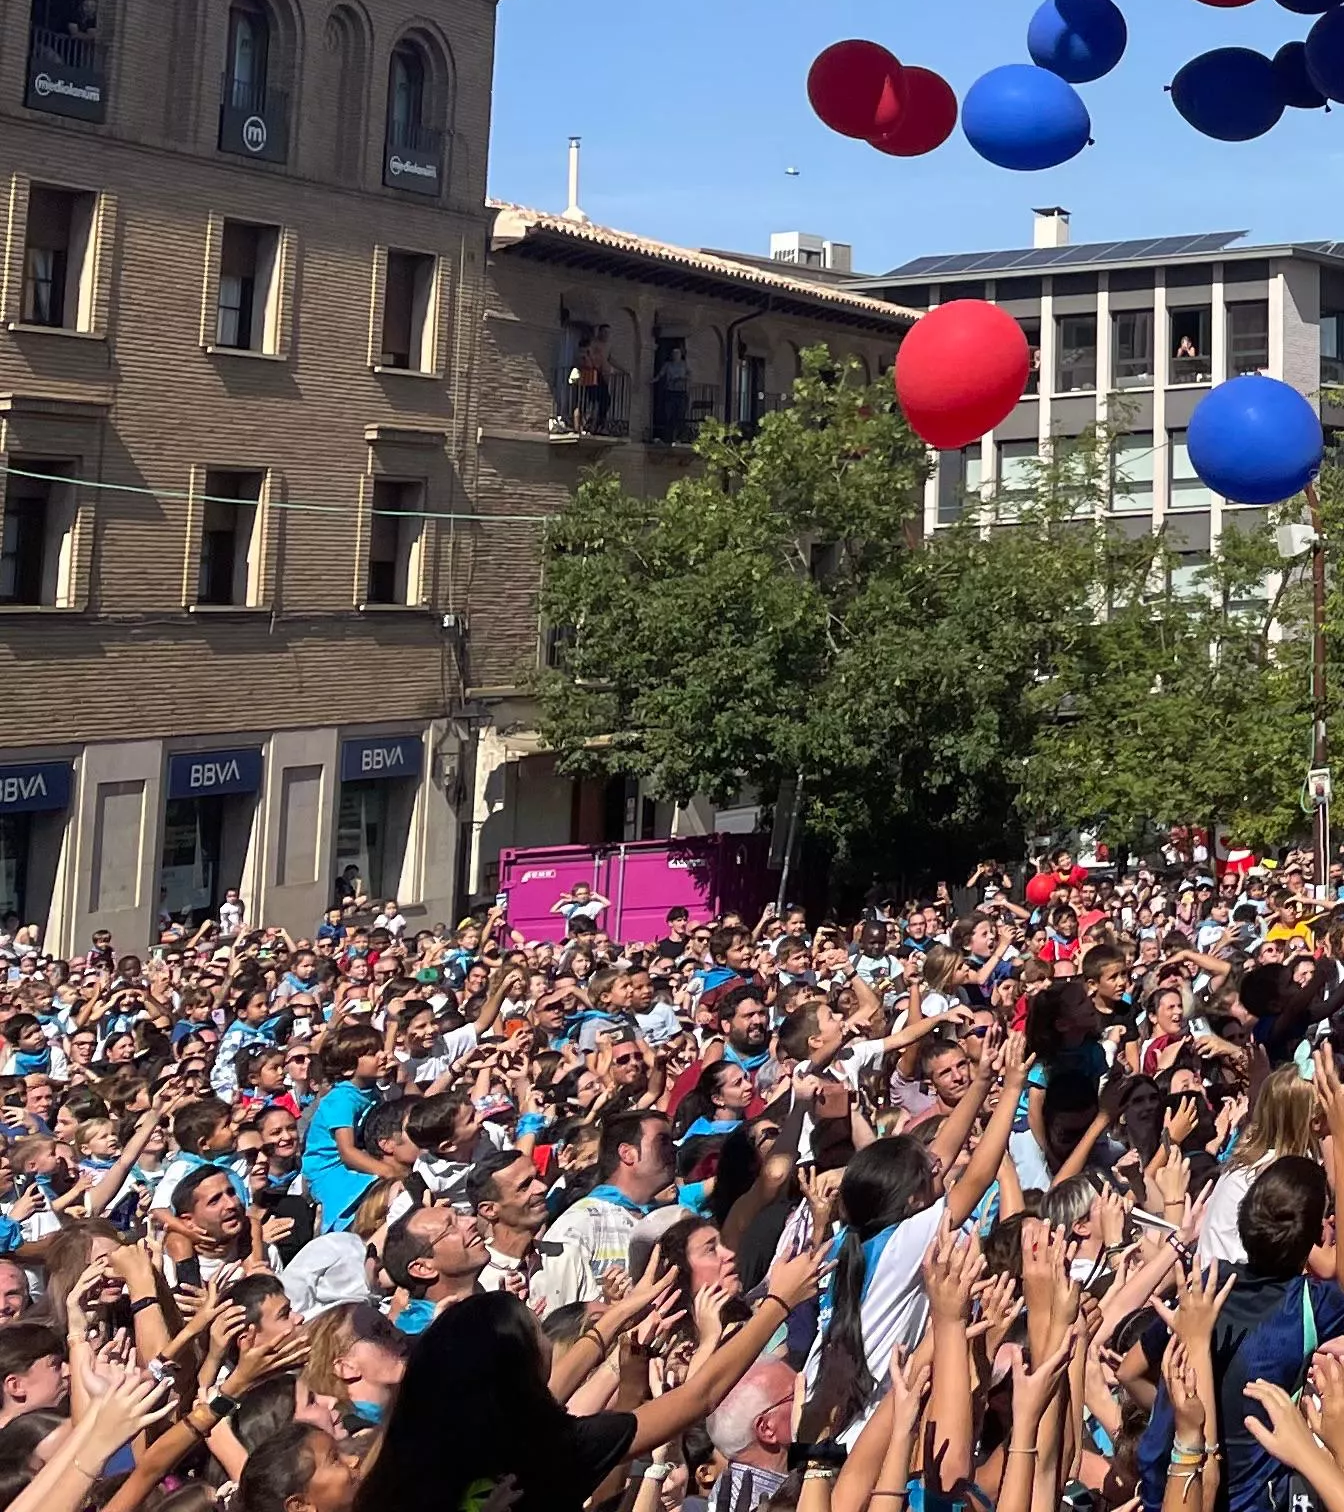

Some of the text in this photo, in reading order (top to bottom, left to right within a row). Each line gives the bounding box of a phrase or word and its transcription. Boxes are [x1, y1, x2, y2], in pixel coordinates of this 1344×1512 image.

[362, 745, 404, 771] BBVA
[190, 759, 240, 787] BBVA
[0, 773, 48, 802] BVA
